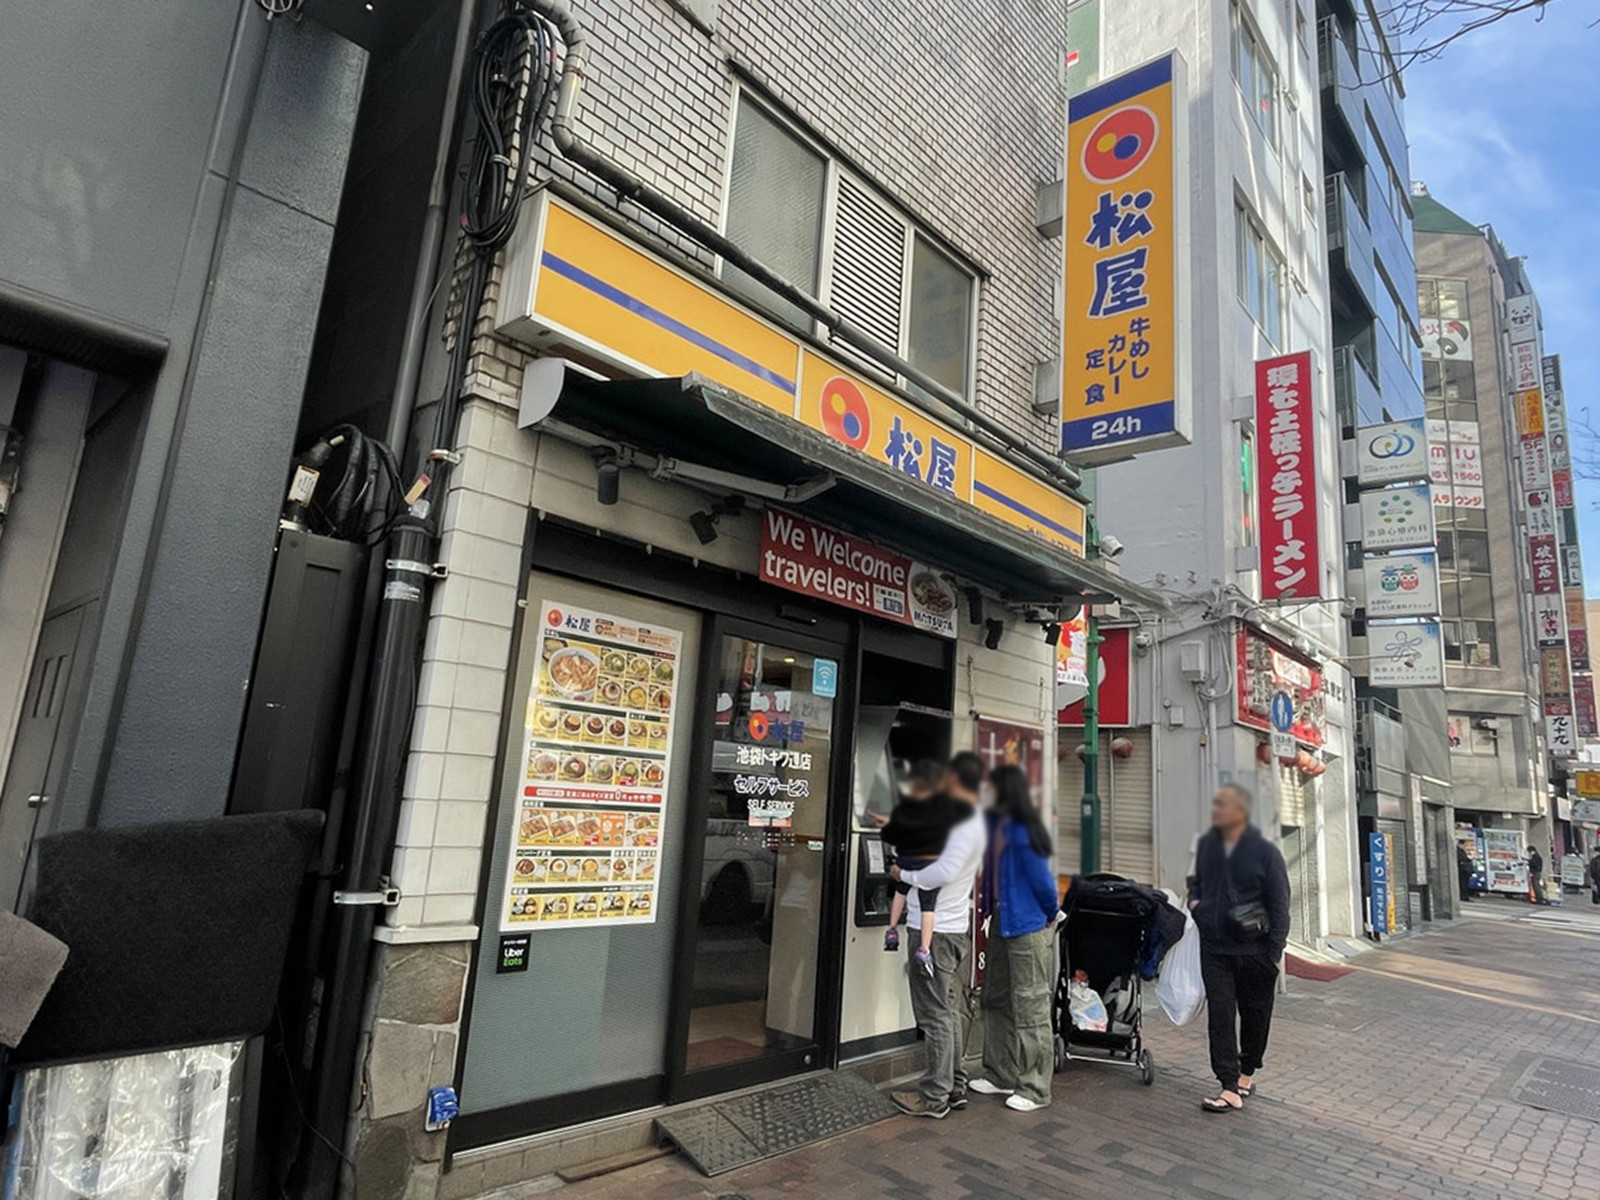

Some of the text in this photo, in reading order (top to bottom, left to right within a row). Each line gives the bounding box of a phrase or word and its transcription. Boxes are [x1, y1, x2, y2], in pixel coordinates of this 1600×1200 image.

[1086, 191, 1153, 318] 松屋
[1130, 318, 1150, 379] 牛めし
[1086, 350, 1105, 405] 定食
[1109, 334, 1126, 394] カレー
[1091, 416, 1142, 440] 24h
[884, 416, 957, 497] 松屋
[767, 510, 905, 586] We Welcome
[765, 549, 871, 607] travelers!
[565, 614, 591, 632] 松屋
[772, 718, 804, 742] 松屋
[1552, 717, 1569, 745] 九十九
[736, 746, 812, 770] 池袋トキワ通店
[733, 774, 809, 797] セルフサービス
[747, 799, 795, 812] SELF SERVICE
[1374, 837, 1385, 877] くすり
[503, 958, 523, 966] Eats
[504, 948, 524, 957] Uber
